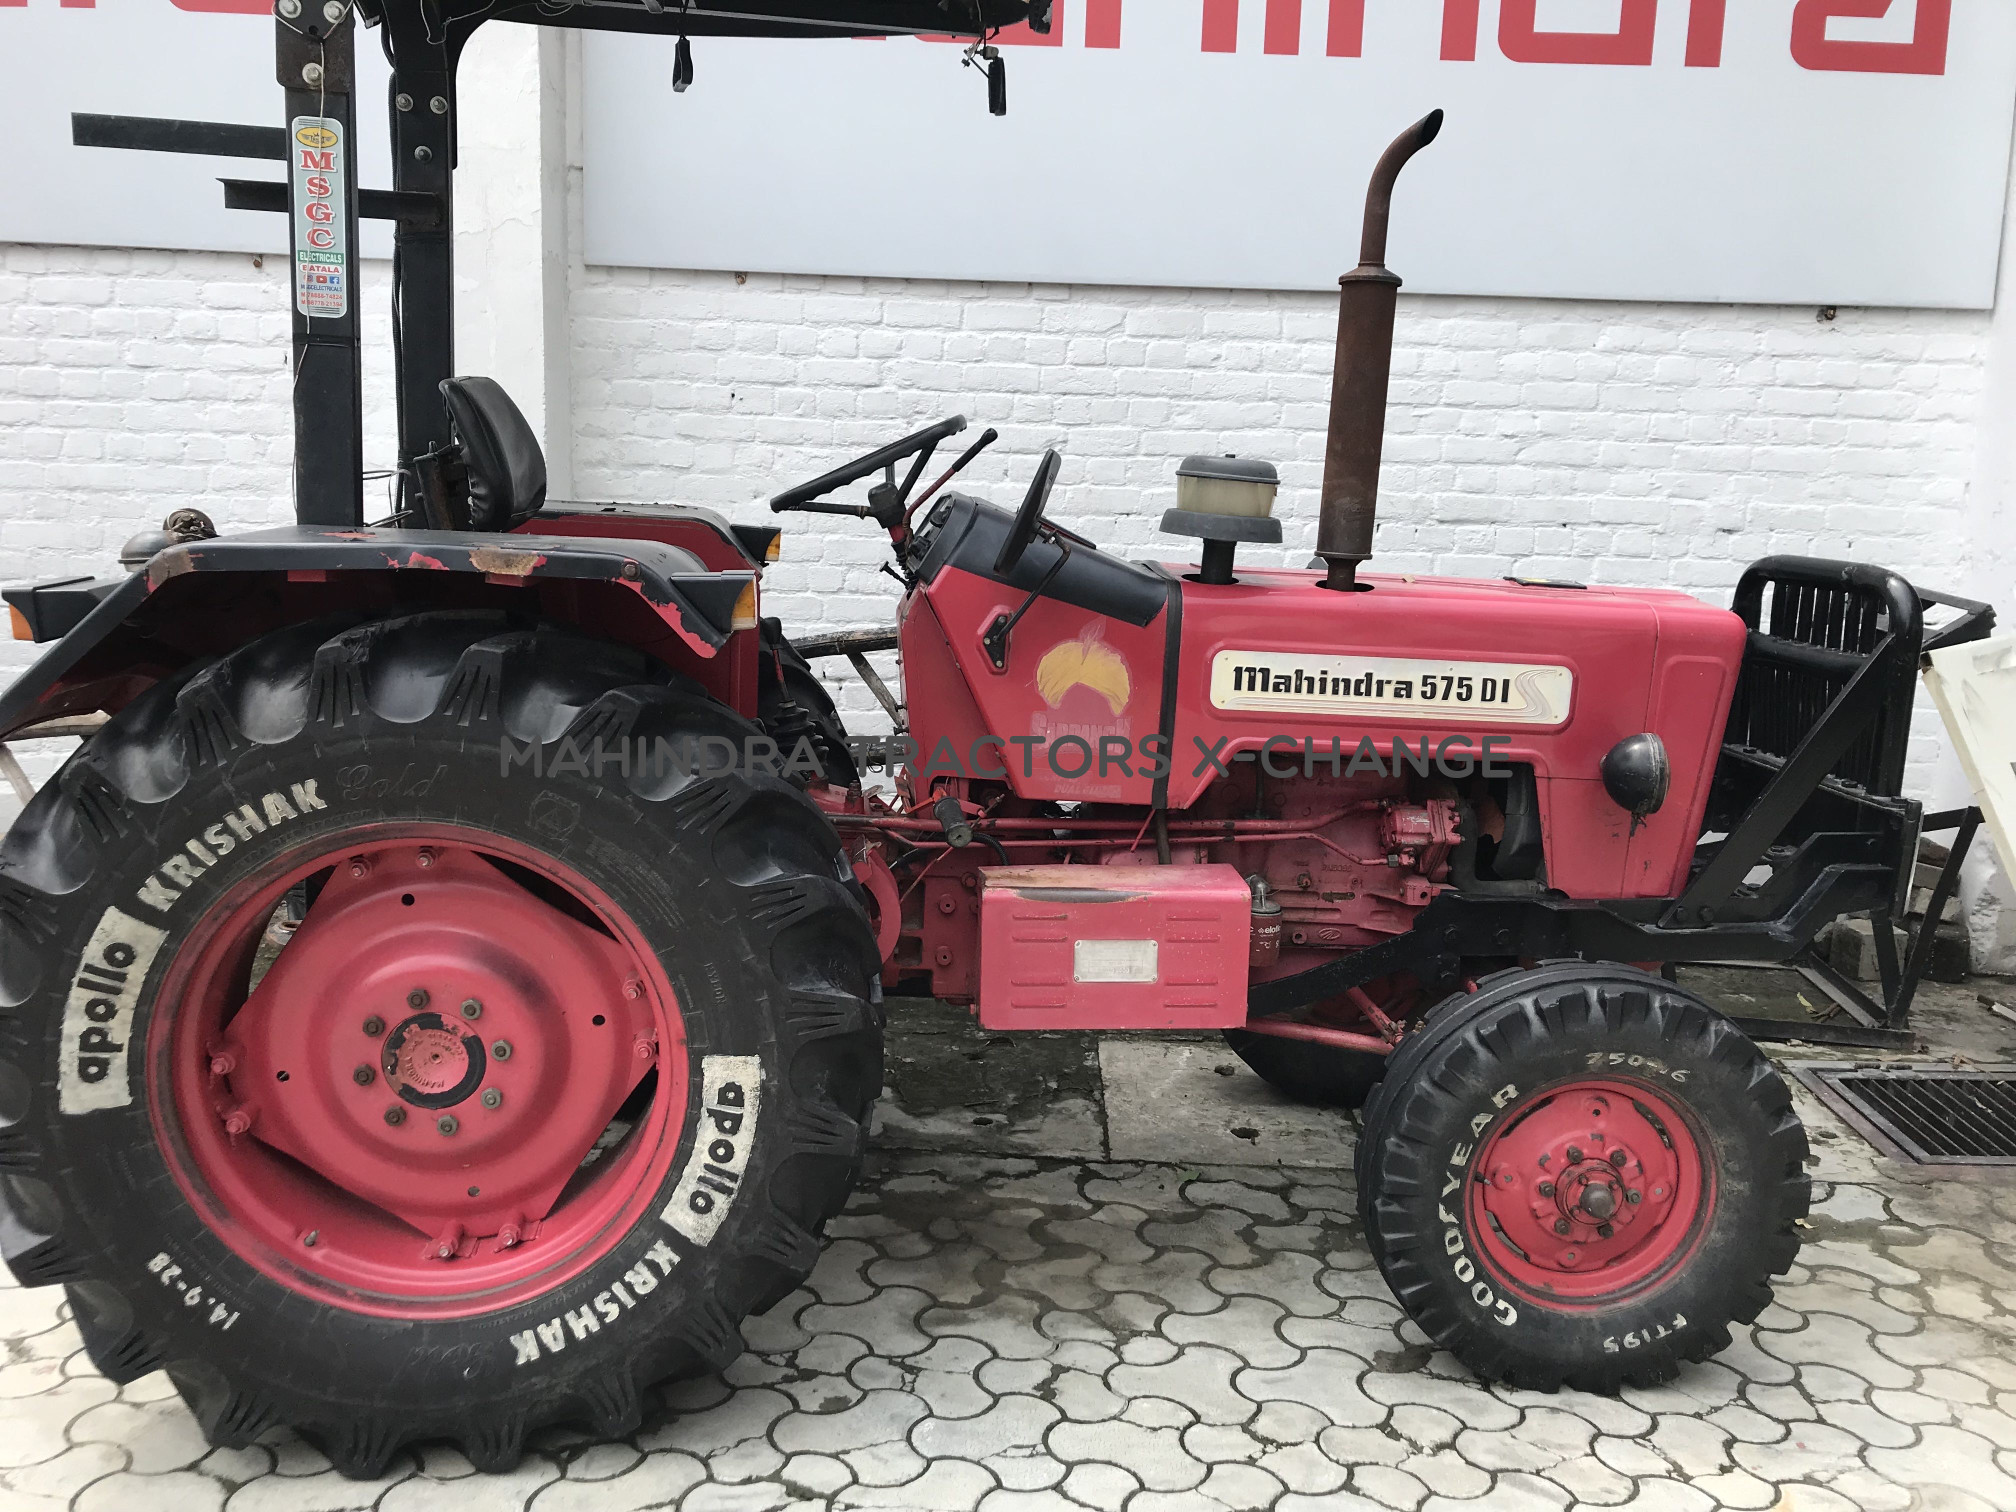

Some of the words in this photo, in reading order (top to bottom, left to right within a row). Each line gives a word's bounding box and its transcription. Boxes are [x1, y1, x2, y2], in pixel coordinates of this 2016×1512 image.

[299, 252, 342, 263] ELECTRICALS
[302, 265, 340, 274] BATALA
[1233, 666, 1414, 699] Mahindra
[1420, 674, 1473, 702] 575
[1481, 677, 1511, 703] DI
[137, 778, 328, 912] KRISHAK
[77, 941, 136, 1084] apollo
[690, 1081, 745, 1215] apollo
[1439, 1083, 1520, 1326] GOODYEAR
[147, 1251, 241, 1331] 14.9-28
[509, 1239, 682, 1366] KRISHAK
